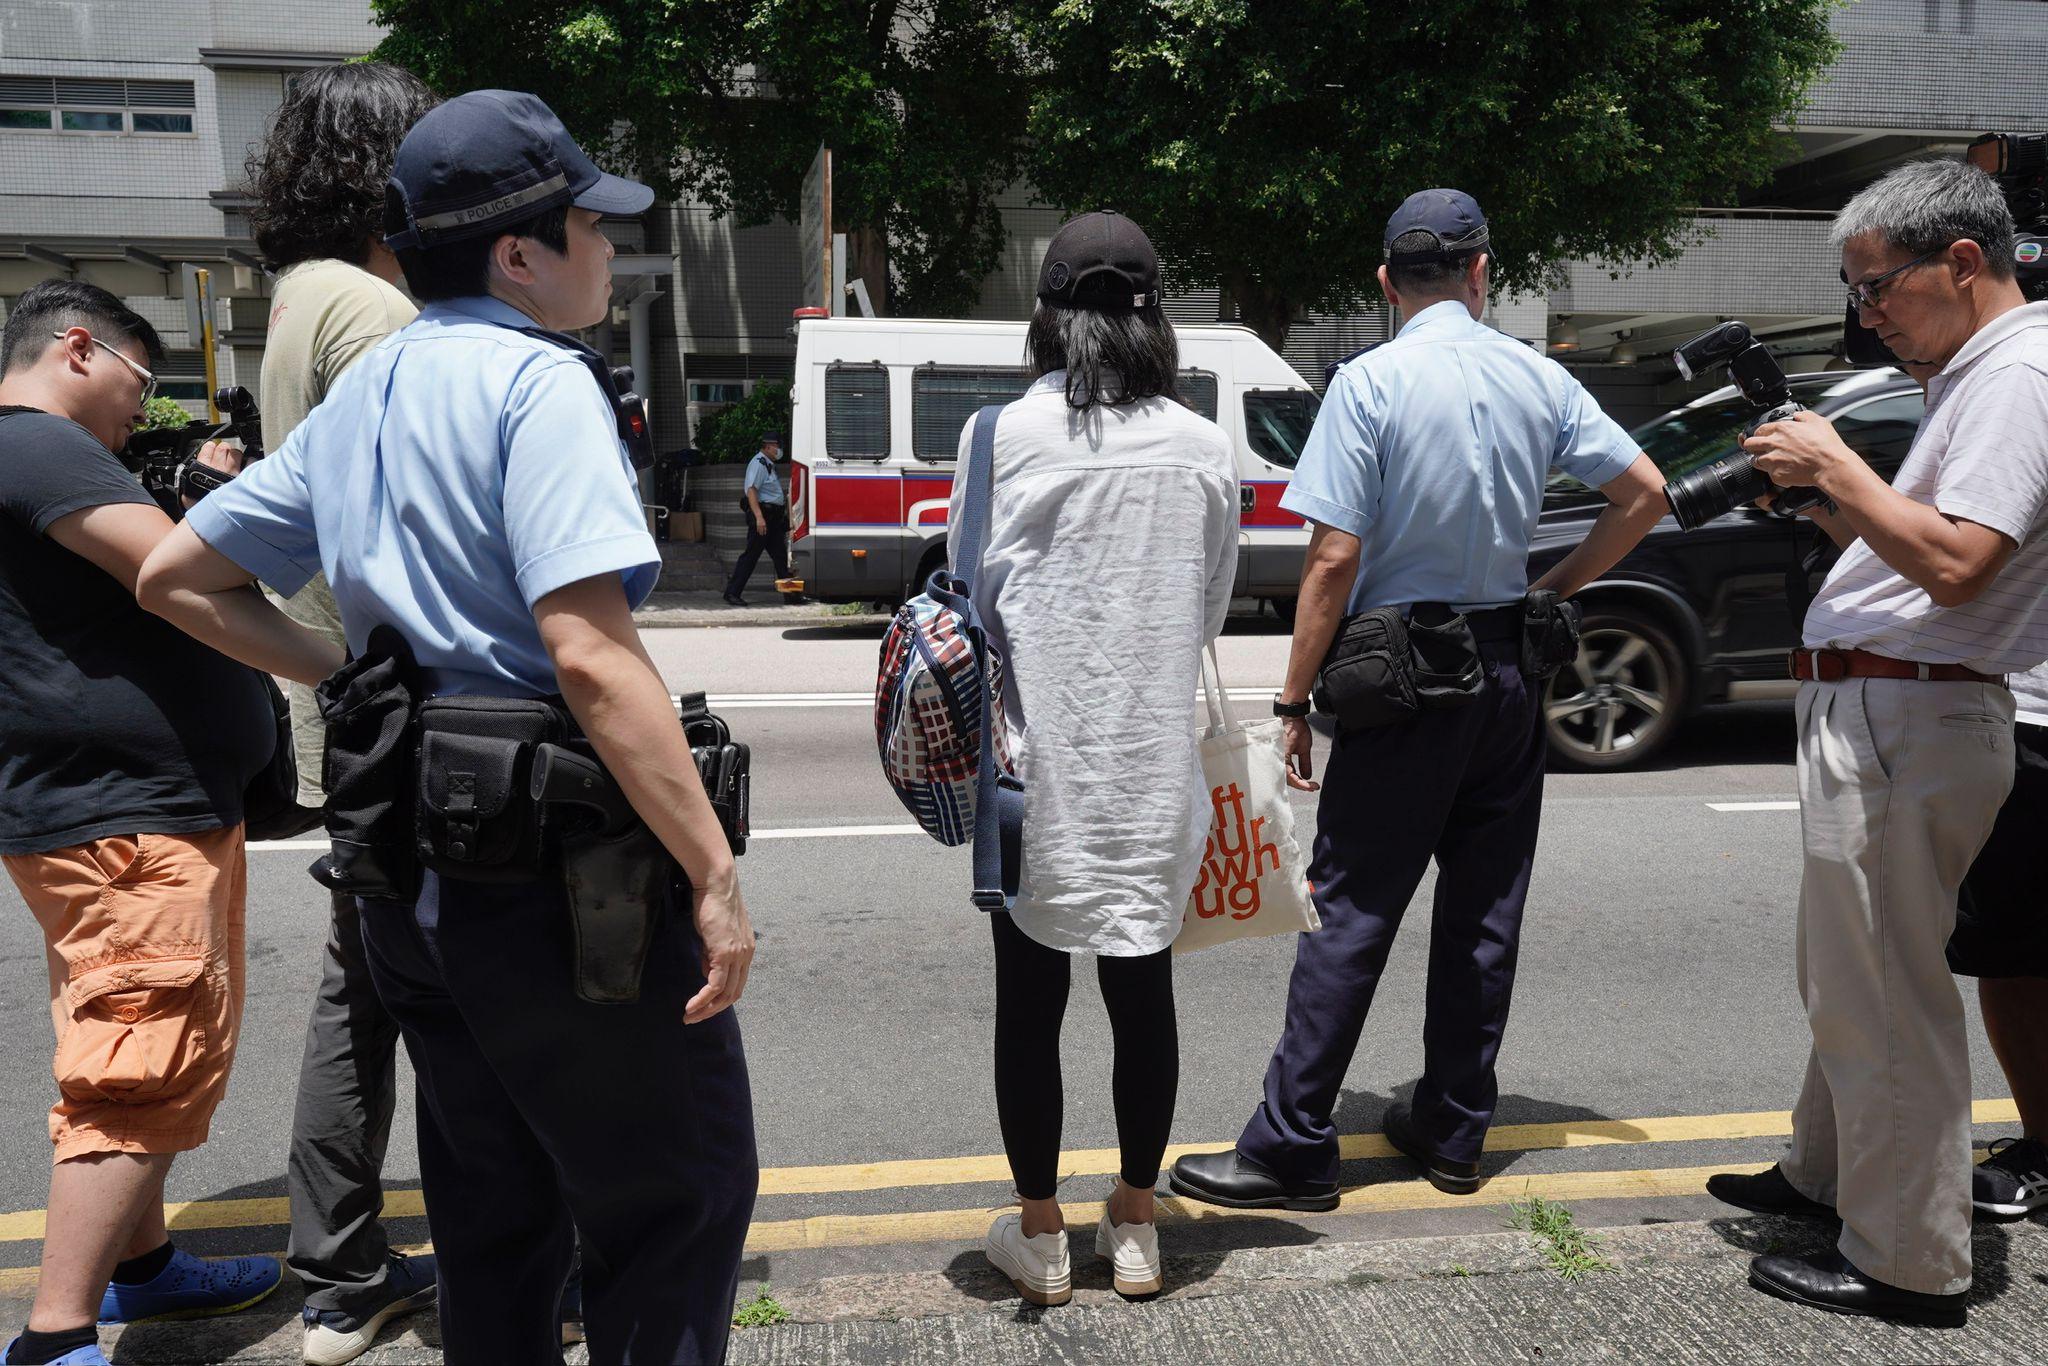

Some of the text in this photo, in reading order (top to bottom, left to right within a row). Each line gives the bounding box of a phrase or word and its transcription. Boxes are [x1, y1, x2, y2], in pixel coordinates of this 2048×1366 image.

[467, 198, 513, 221] POLICE
[1210, 782, 1245, 829] ft
[1184, 878, 1261, 921] ug
